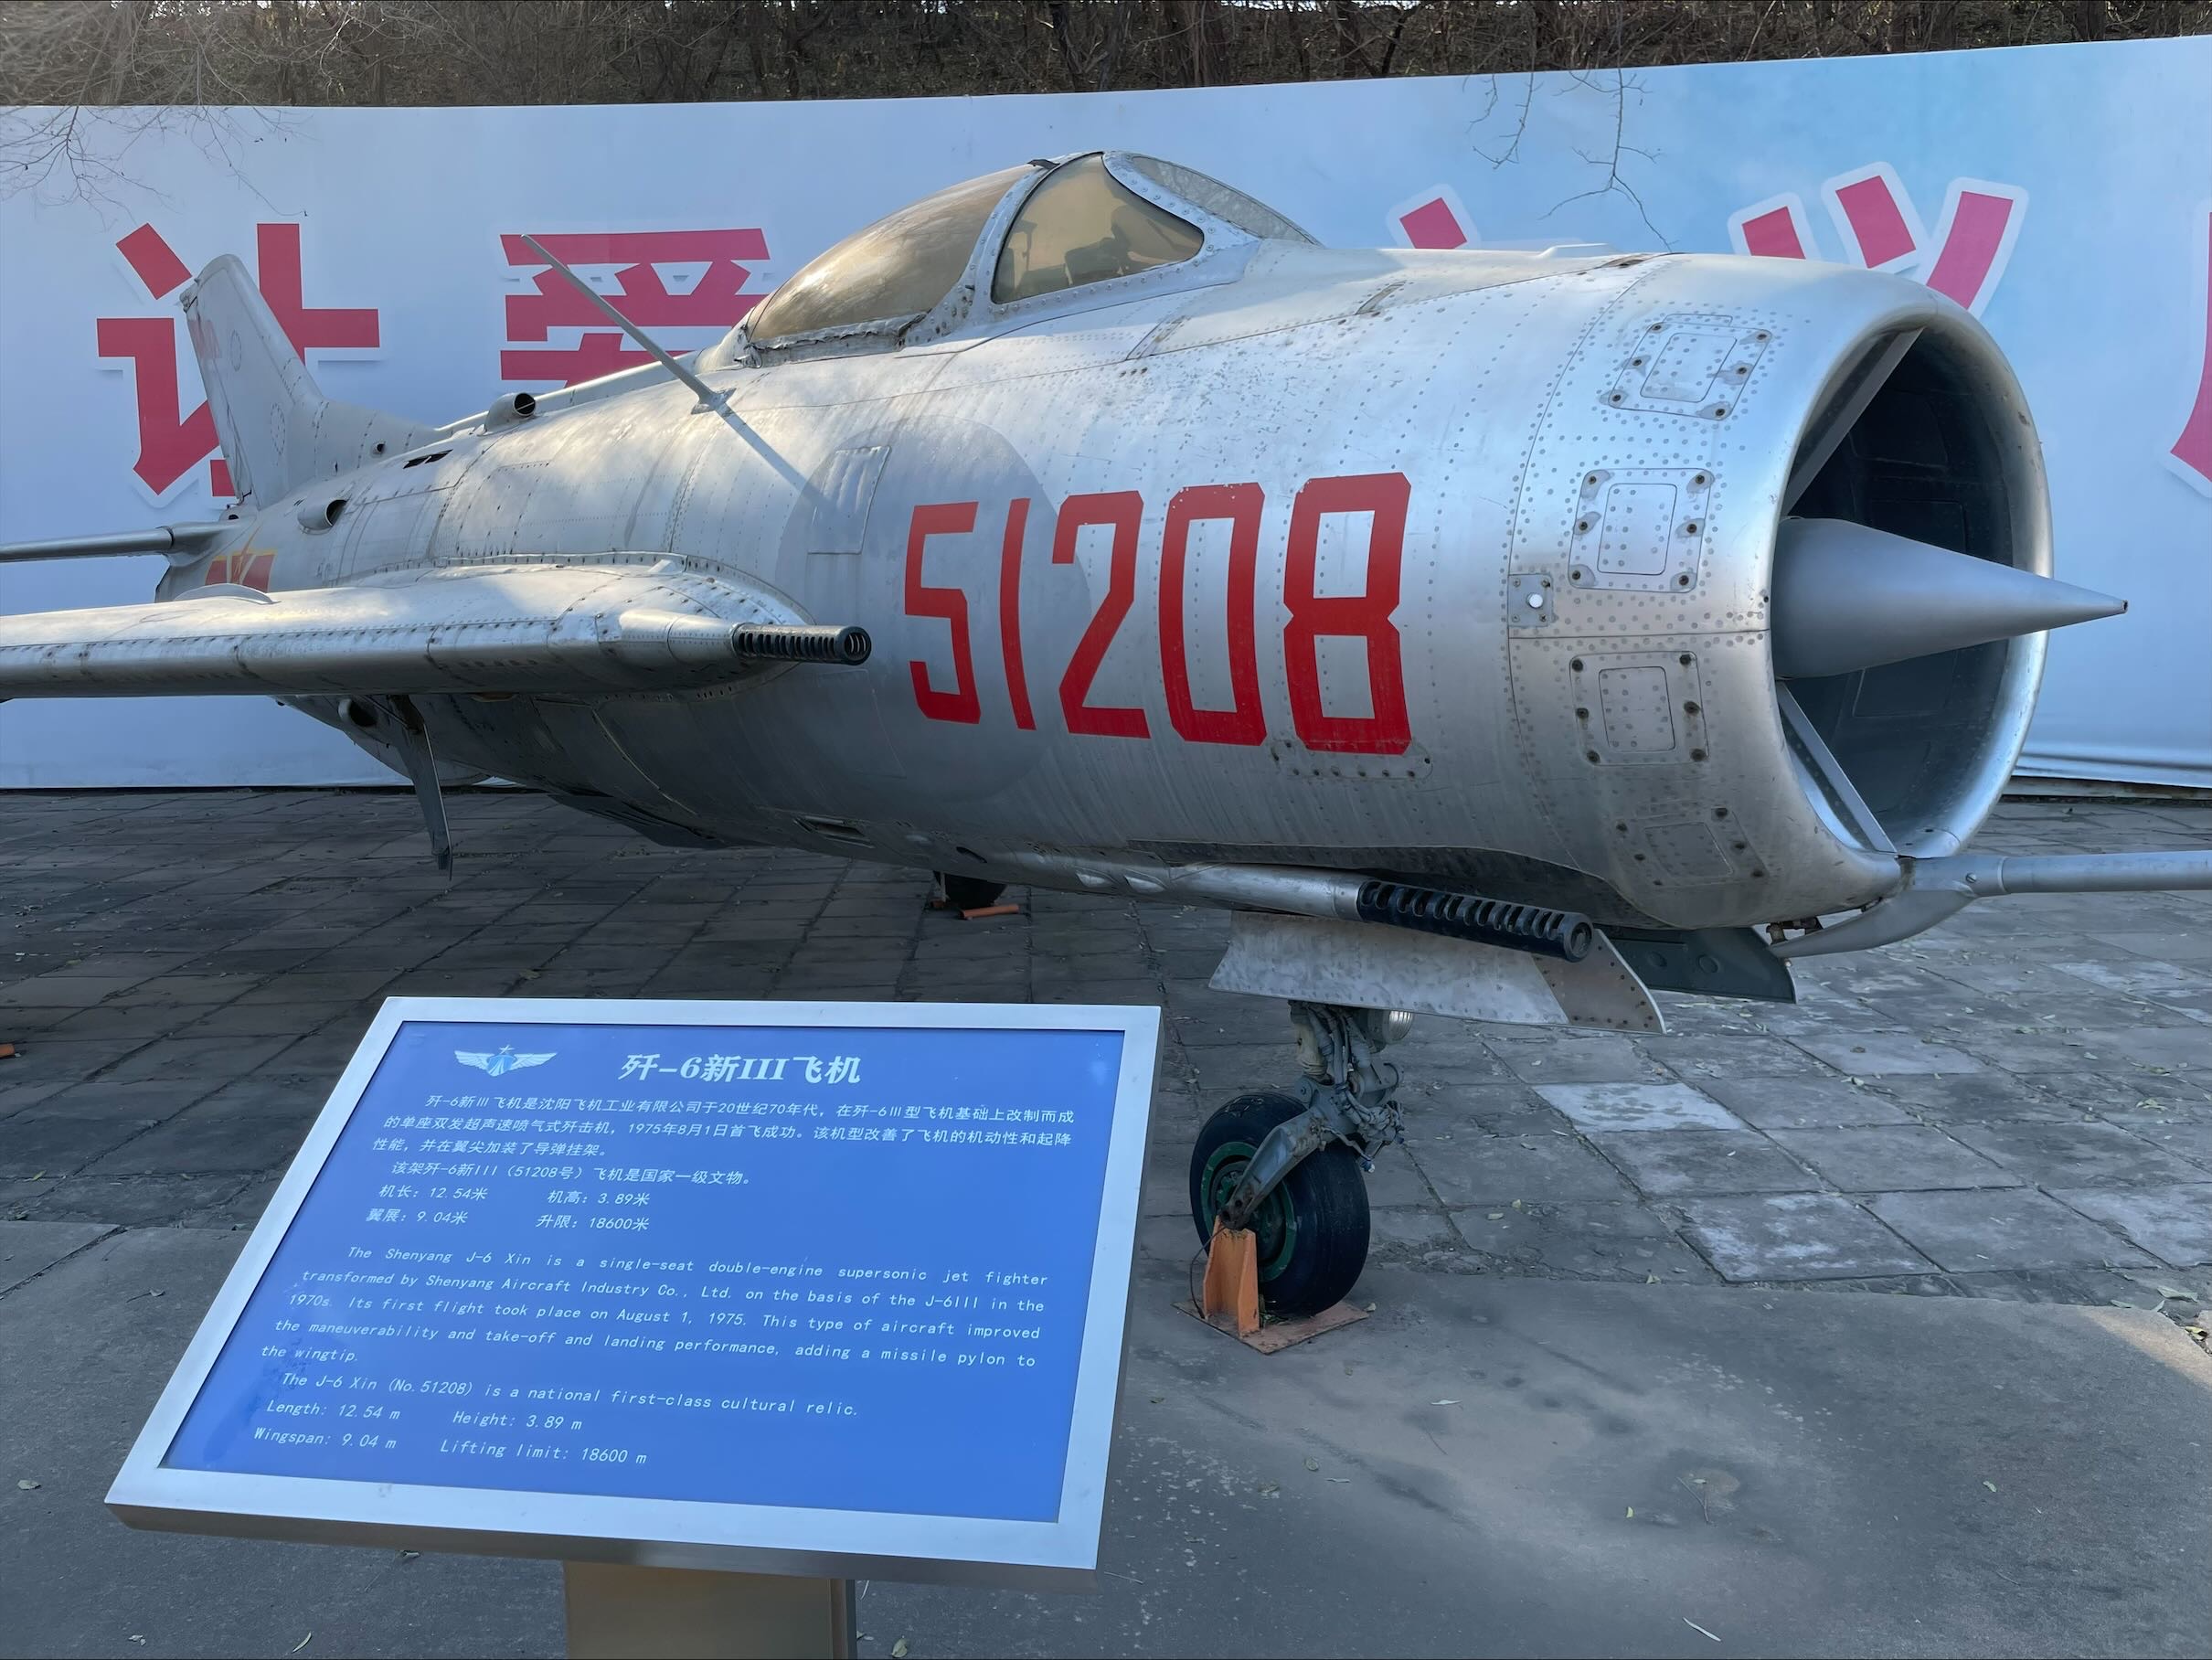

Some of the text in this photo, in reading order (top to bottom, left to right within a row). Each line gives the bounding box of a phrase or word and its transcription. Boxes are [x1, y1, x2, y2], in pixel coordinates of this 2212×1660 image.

[904, 472, 1411, 755] 51208
[348, 1246, 1048, 1286] The Shenyang J-6 Xin is a single-seat double-engine supersonic jet fighter
[303, 1271, 1045, 1313] transformed by Shenyang Aircraft Industry Co., Ltd. on the basis of the J-6III in the
[348, 1296, 373, 1309] Its
[382, 1298, 424, 1312] first
[434, 1300, 484, 1315] flight
[495, 1304, 529, 1316] took
[536, 1305, 581, 1319] place
[590, 1310, 609, 1320] on
[615, 1308, 671, 1324] August
[682, 1311, 692, 1325] 1,
[709, 1312, 747, 1326] 1975.
[763, 1314, 798, 1328] This
[808, 1317, 844, 1332] type
[853, 1318, 873, 1331] of
[881, 1320, 955, 1335] aircraft
[967, 1323, 1041, 1339] improved
[261, 1345, 358, 1363] the wingtip.
[275, 1319, 1036, 1367] the maneuverability and take-off and landing performance, adding a missile pylon to
[266, 1399, 401, 1420] Length: 12.54 m
[282, 1372, 308, 1387] The
[315, 1375, 344, 1389] J-6
[348, 1376, 378, 1390] Xin
[484, 1383, 502, 1397] is
[509, 1389, 520, 1398] a
[527, 1387, 601, 1402] national
[611, 1389, 712, 1408] first-class
[721, 1397, 795, 1412] cultural
[806, 1400, 857, 1416] relic.
[253, 1427, 397, 1449] Wingspan: 9.04 m
[452, 1410, 583, 1431] Height: 3.89 m
[440, 1439, 647, 1464] Lifting limit: 18600 m
